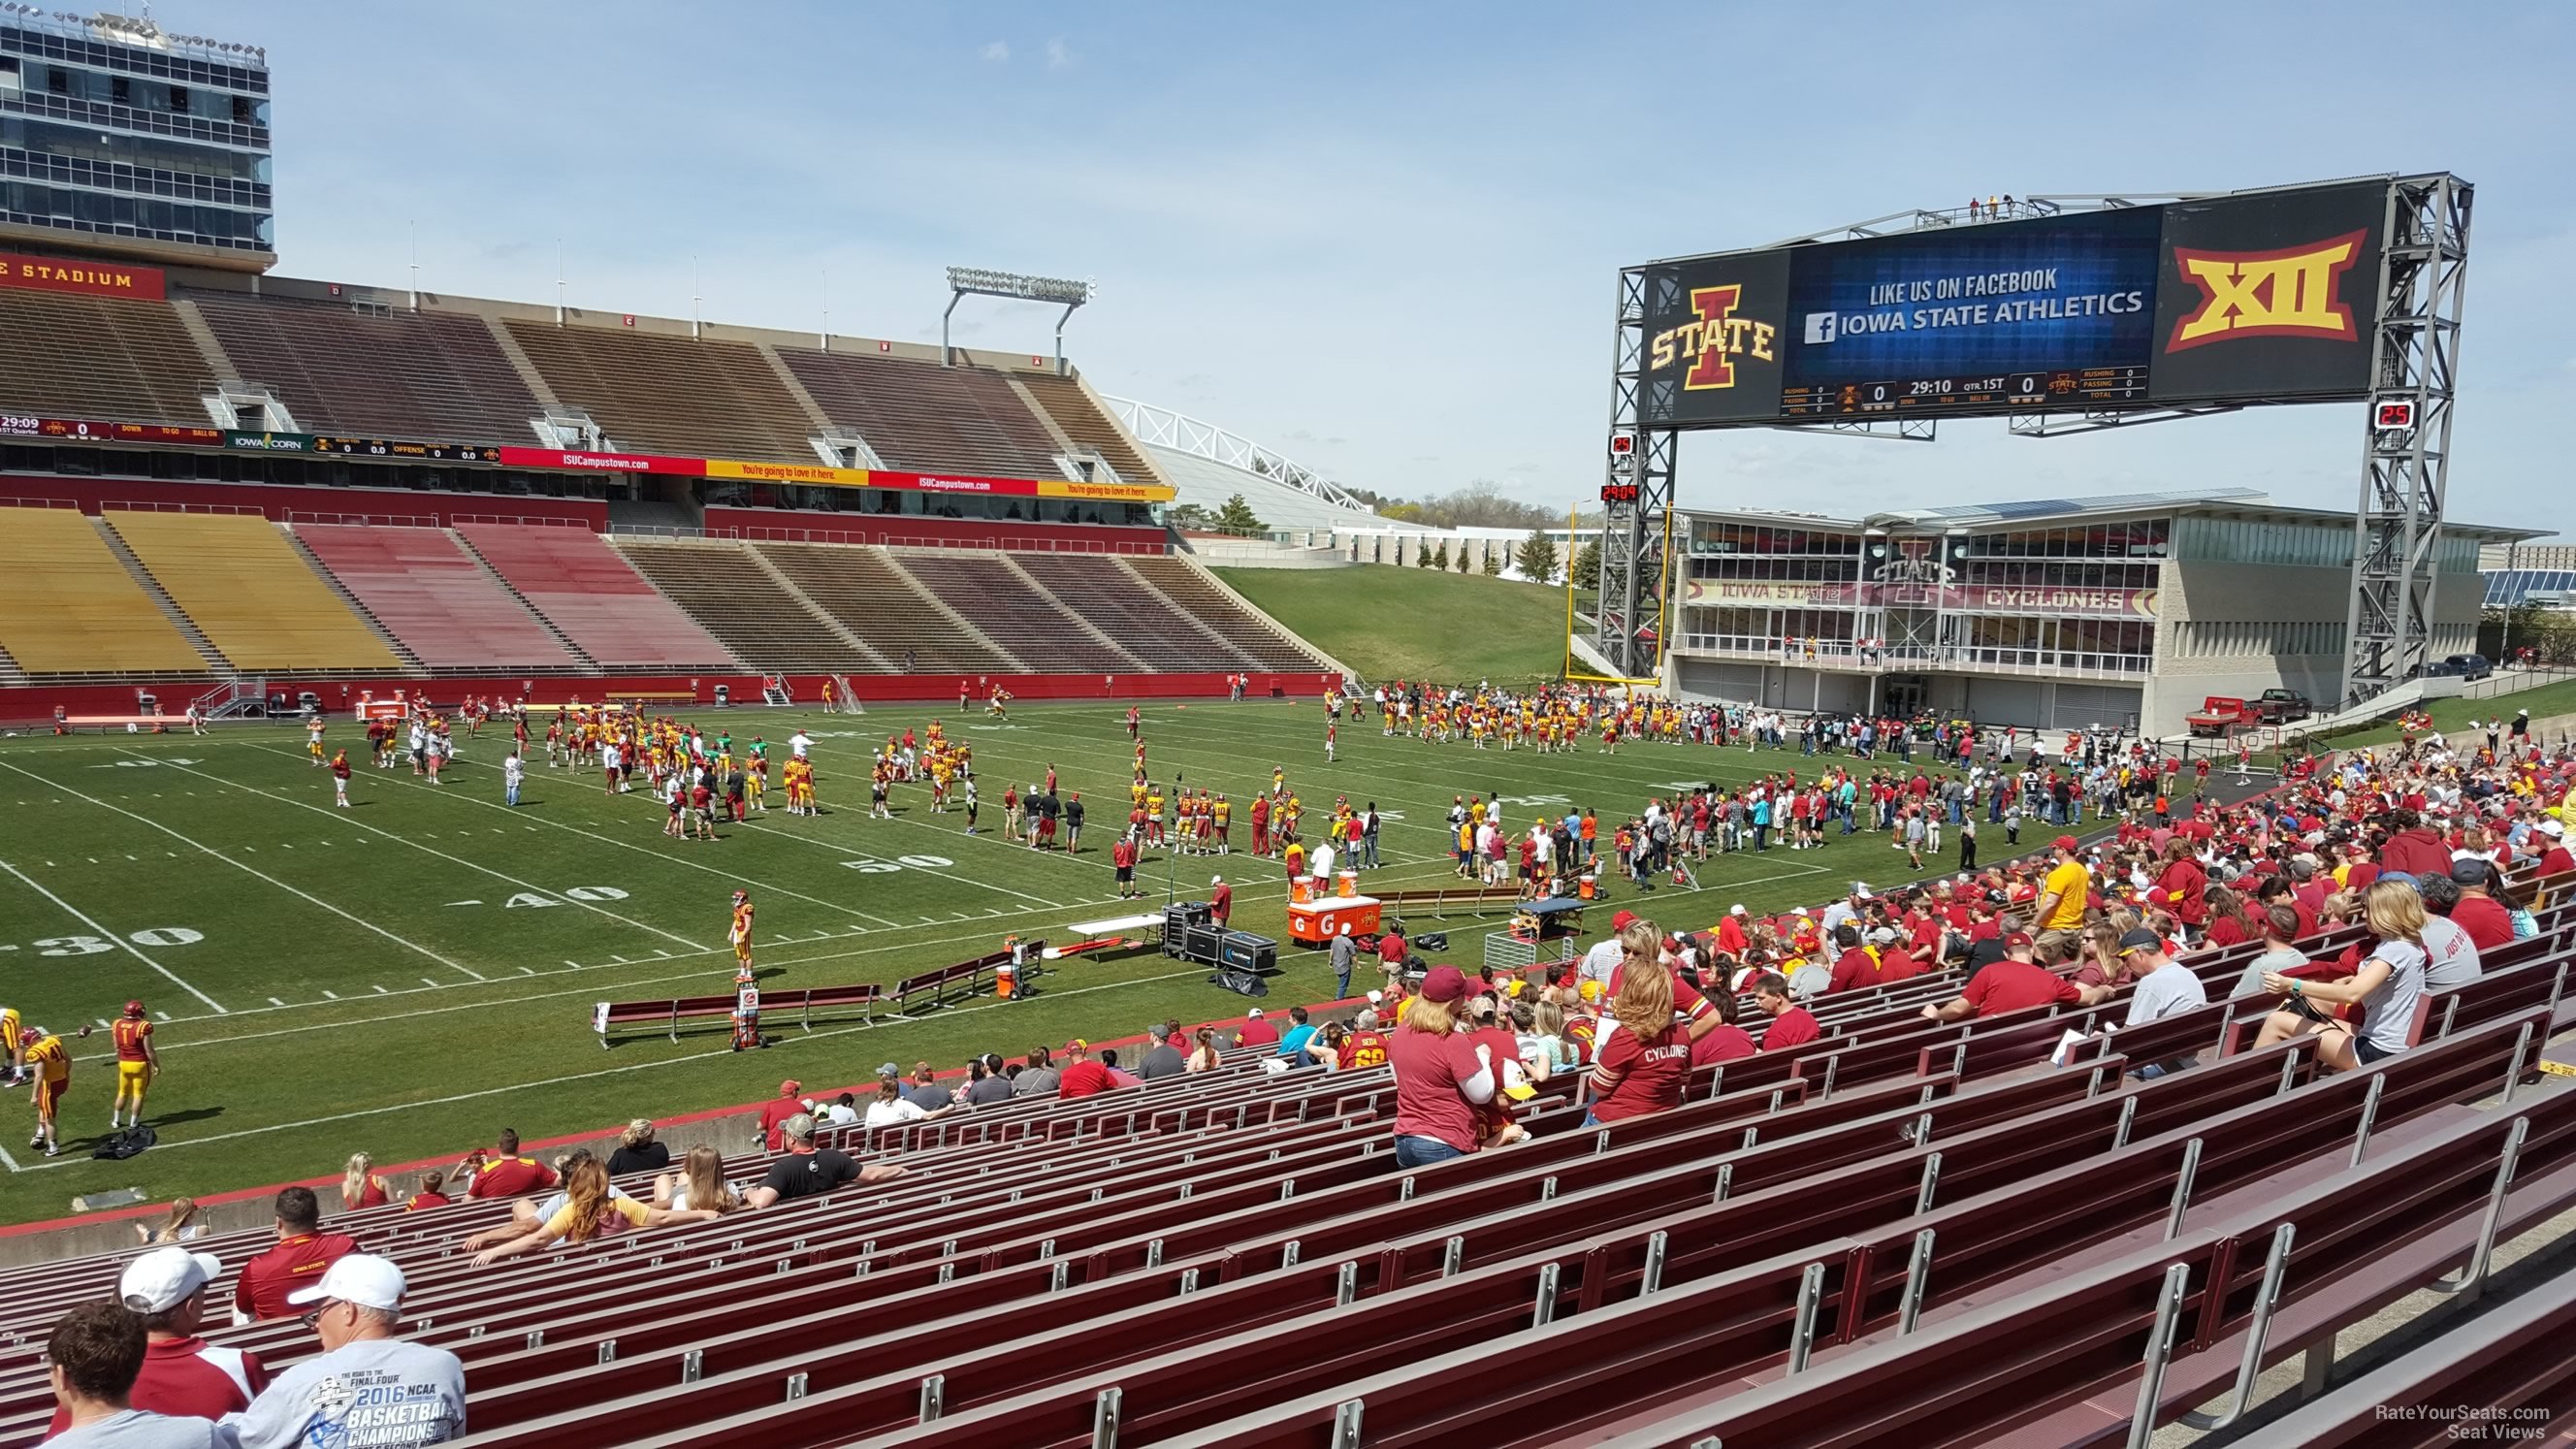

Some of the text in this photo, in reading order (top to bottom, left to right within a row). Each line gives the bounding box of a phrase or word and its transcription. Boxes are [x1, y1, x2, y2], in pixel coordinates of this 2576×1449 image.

[23, 265, 131, 288] STADIUM
[1870, 268, 2057, 306] LIKE US ON FACEBOOK
[2180, 242, 2353, 341] XII
[1842, 312, 1906, 336] IOWA
[1913, 305, 1988, 330] STATE
[1994, 291, 2142, 324] ATHLETICS
[1652, 318, 1775, 370] STATE
[1911, 379, 1951, 395] 29:10
[1982, 378, 2005, 390] 1ST
[2021, 377, 2034, 393] 0
[1874, 386, 1884, 401] 0
[1, 416, 39, 429] 29:09
[2381, 405, 2407, 425] 25
[78, 423, 88, 435] 0
[236, 437, 302, 449] IOWA CORN
[343, 444, 351, 453] 0
[370, 446, 386, 455] 0.0
[394, 445, 425, 454] OFFENSE
[1615, 438, 1629, 452] 25
[462, 451, 476, 460] 0.0
[564, 454, 649, 470] ISUCampustown.com
[742, 464, 836, 479] You're going to love it here.
[919, 477, 990, 492] ISUCampustown.com
[1068, 484, 1085, 495] You're
[1086, 486, 1103, 497] going
[1103, 486, 1111, 496] to
[1111, 486, 1124, 496] love
[1131, 487, 1146, 497] here.
[1603, 486, 1635, 499] 29:09
[1722, 582, 1841, 601] IOWA STATE
[1986, 589, 2124, 609] CYCLONES
[840, 855, 954, 873] 50
[505, 886, 629, 909] 40
[1295, 917, 1305, 932] G
[1320, 914, 1335, 935] G
[32, 927, 205, 956] 30
[292, 1261, 326, 1273] IOWA STATE
[350, 1374, 400, 1387] FINAL FOUR
[357, 1385, 405, 1406] 2016
[407, 1384, 435, 1396] NCAA
